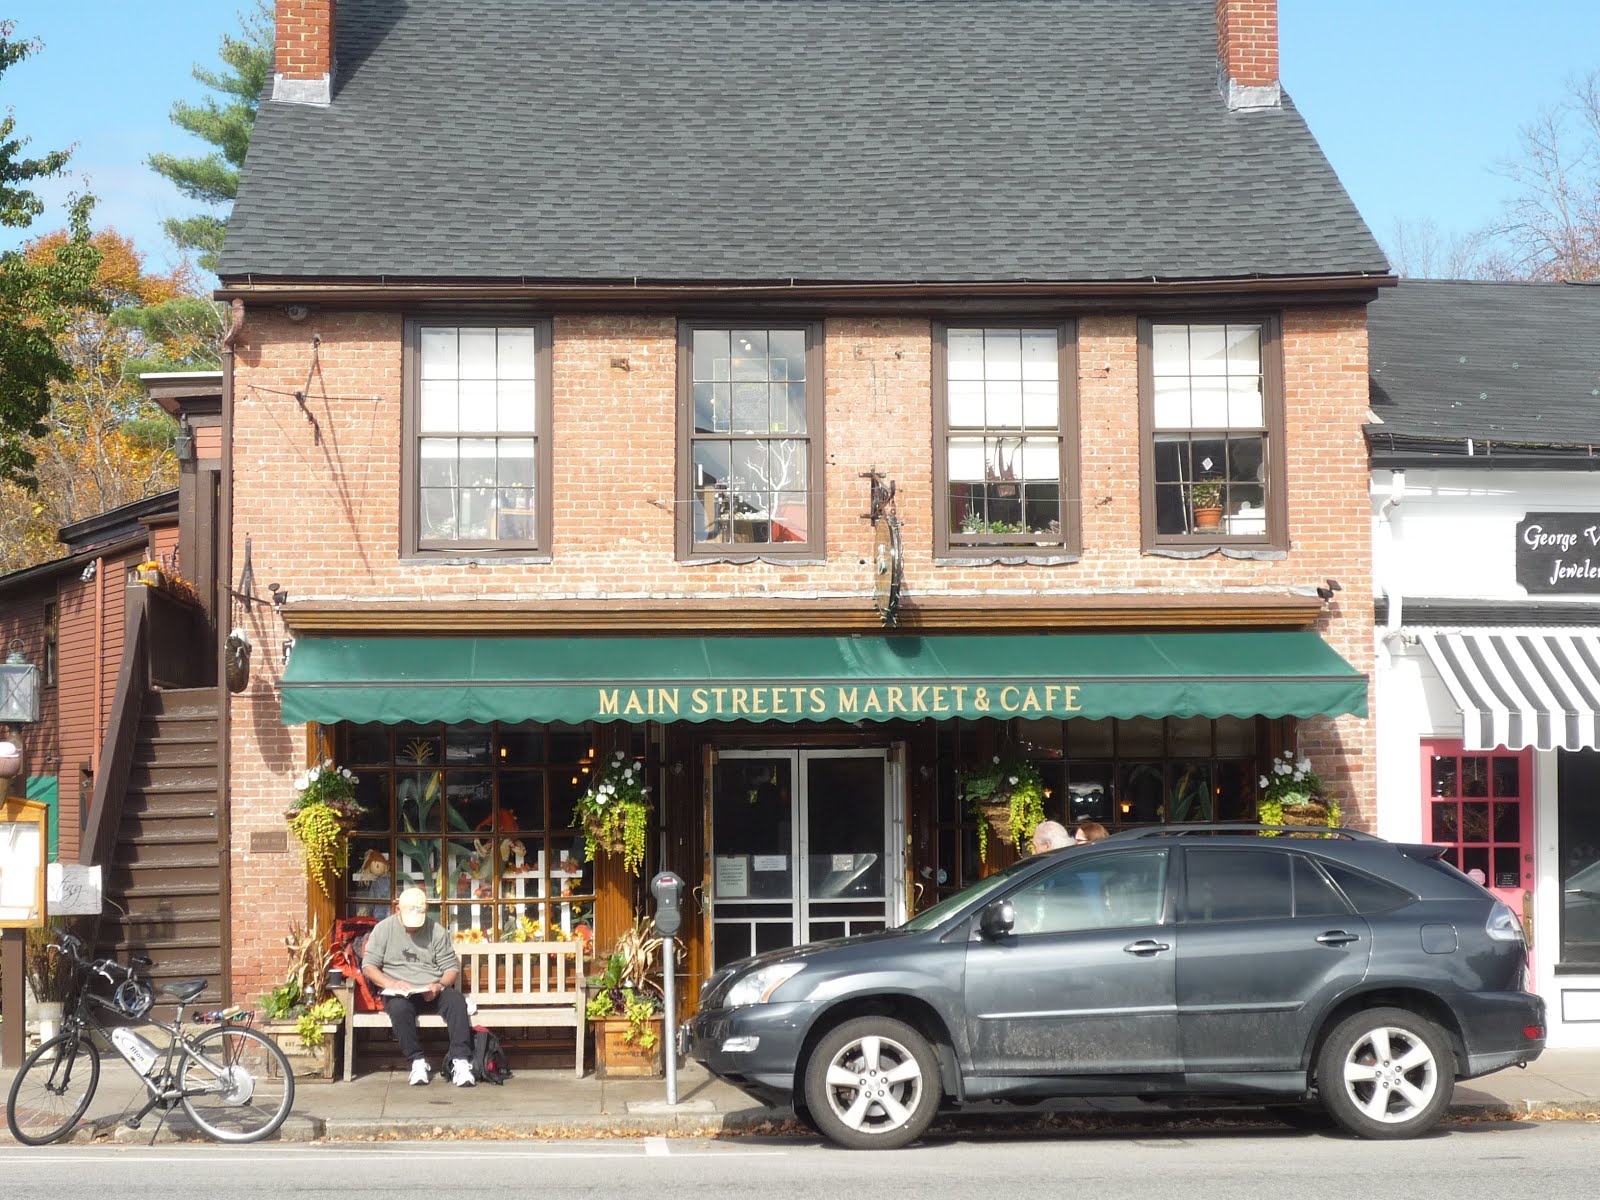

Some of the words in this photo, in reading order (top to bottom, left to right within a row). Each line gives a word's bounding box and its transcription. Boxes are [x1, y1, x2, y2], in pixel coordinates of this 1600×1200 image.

[1524, 525, 1577, 552] George
[599, 688, 679, 715] MAIN
[691, 687, 826, 714] STREETS
[838, 686, 967, 713] MARKET
[974, 687, 990, 711] &
[1000, 685, 1082, 712] CAFE
